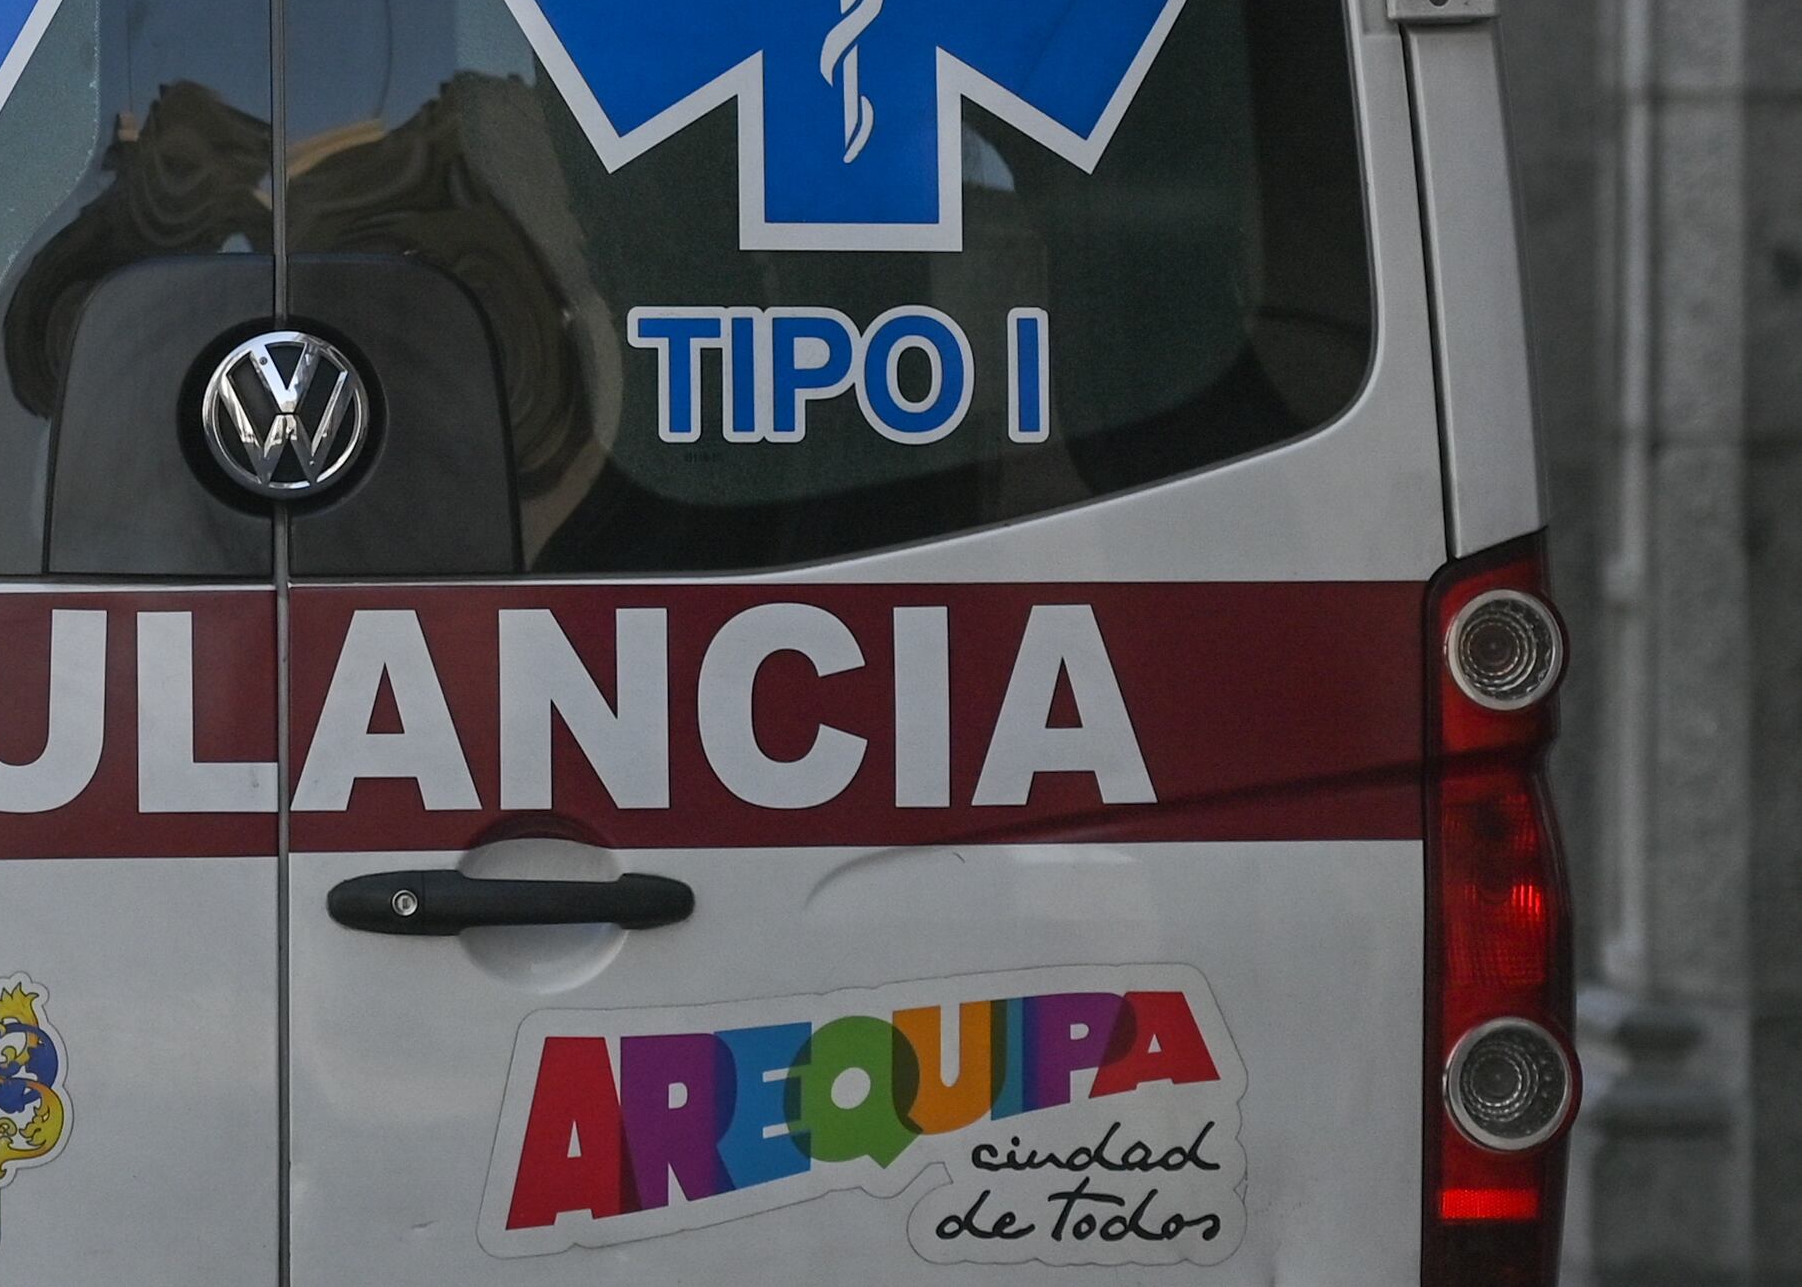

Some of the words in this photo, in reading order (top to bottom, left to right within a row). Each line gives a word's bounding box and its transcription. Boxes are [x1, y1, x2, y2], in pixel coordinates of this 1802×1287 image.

[627, 305, 975, 445] TIPO
[1007, 307, 1050, 444] I
[506, 991, 1221, 1231] AREQUIPA
[971, 1121, 1221, 1172] ciudad
[935, 1189, 1036, 1240] de
